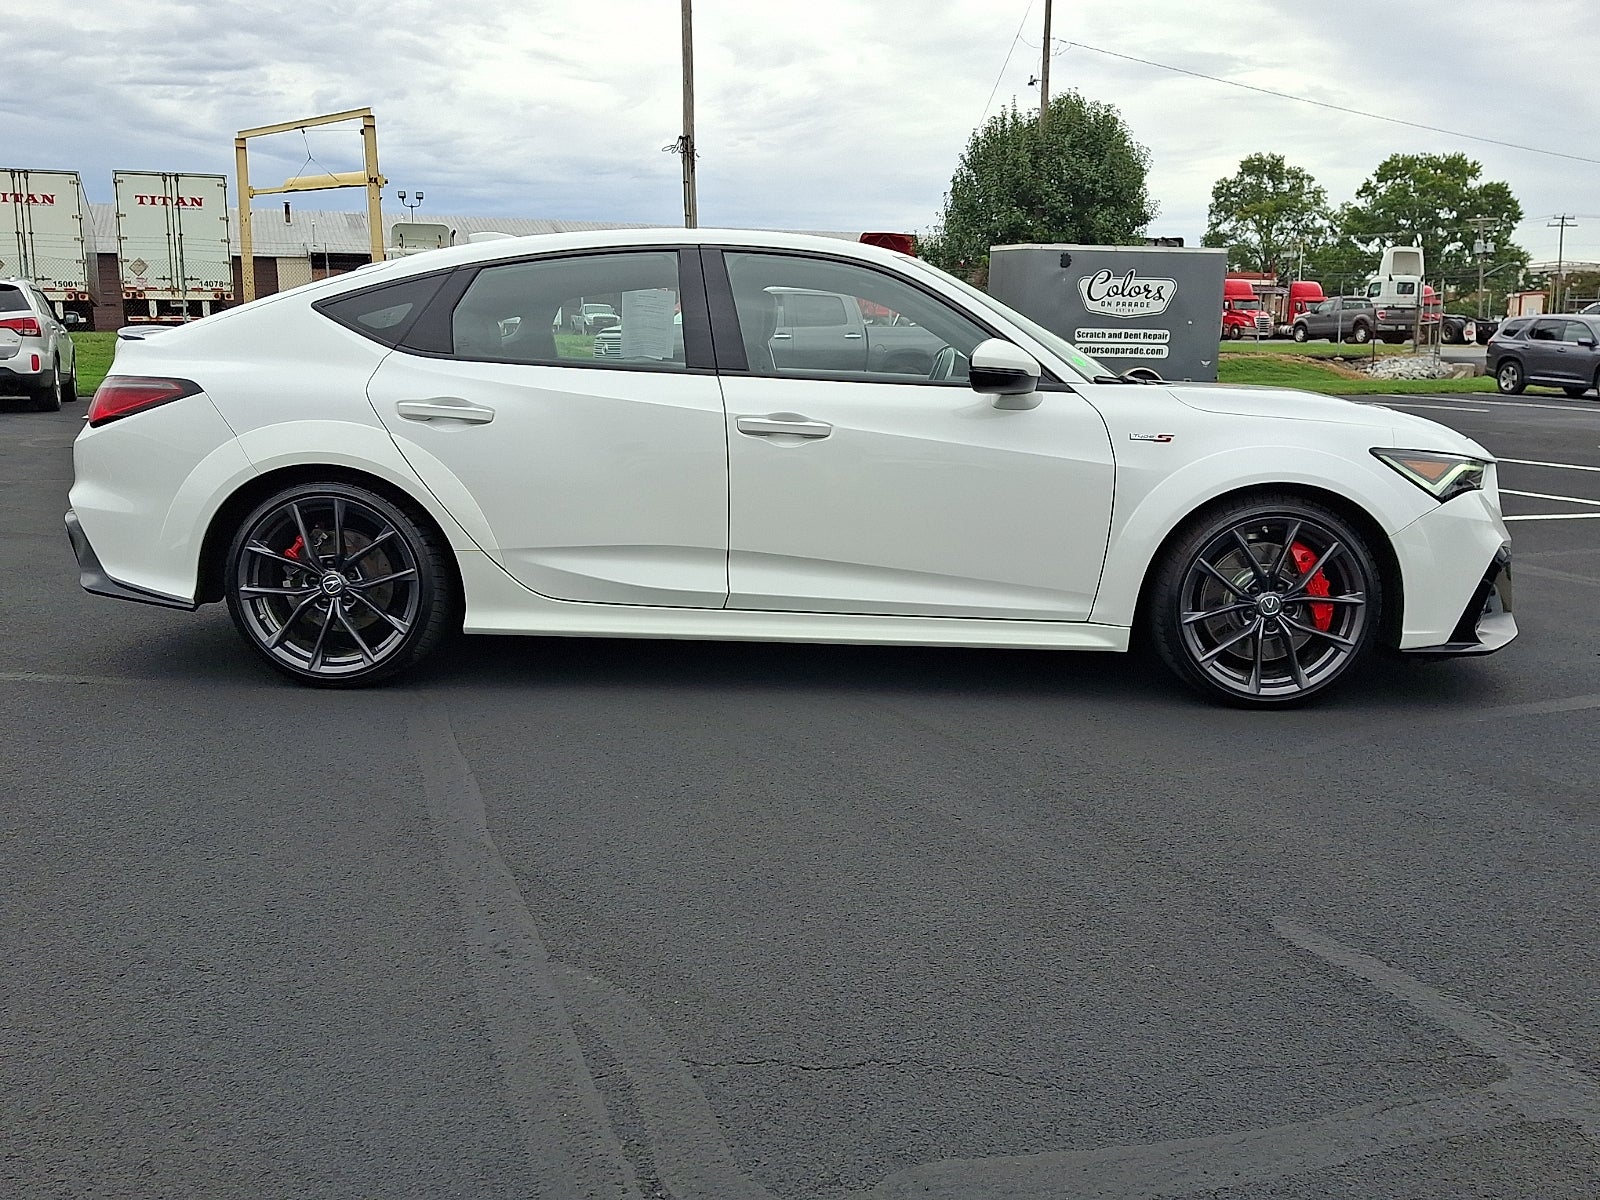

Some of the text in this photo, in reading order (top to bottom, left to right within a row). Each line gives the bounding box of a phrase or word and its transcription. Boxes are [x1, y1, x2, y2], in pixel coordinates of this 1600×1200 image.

[0, 192, 56, 205] ITAN
[134, 194, 204, 207] TITAN
[53, 280, 78, 288] 15001
[199, 280, 224, 288] 14078
[1087, 270, 1165, 302] Colors
[1100, 300, 1113, 308] ON
[1076, 330, 1169, 341] Scratch and Dent Repair
[1079, 345, 1164, 356] colorsonparade.com
